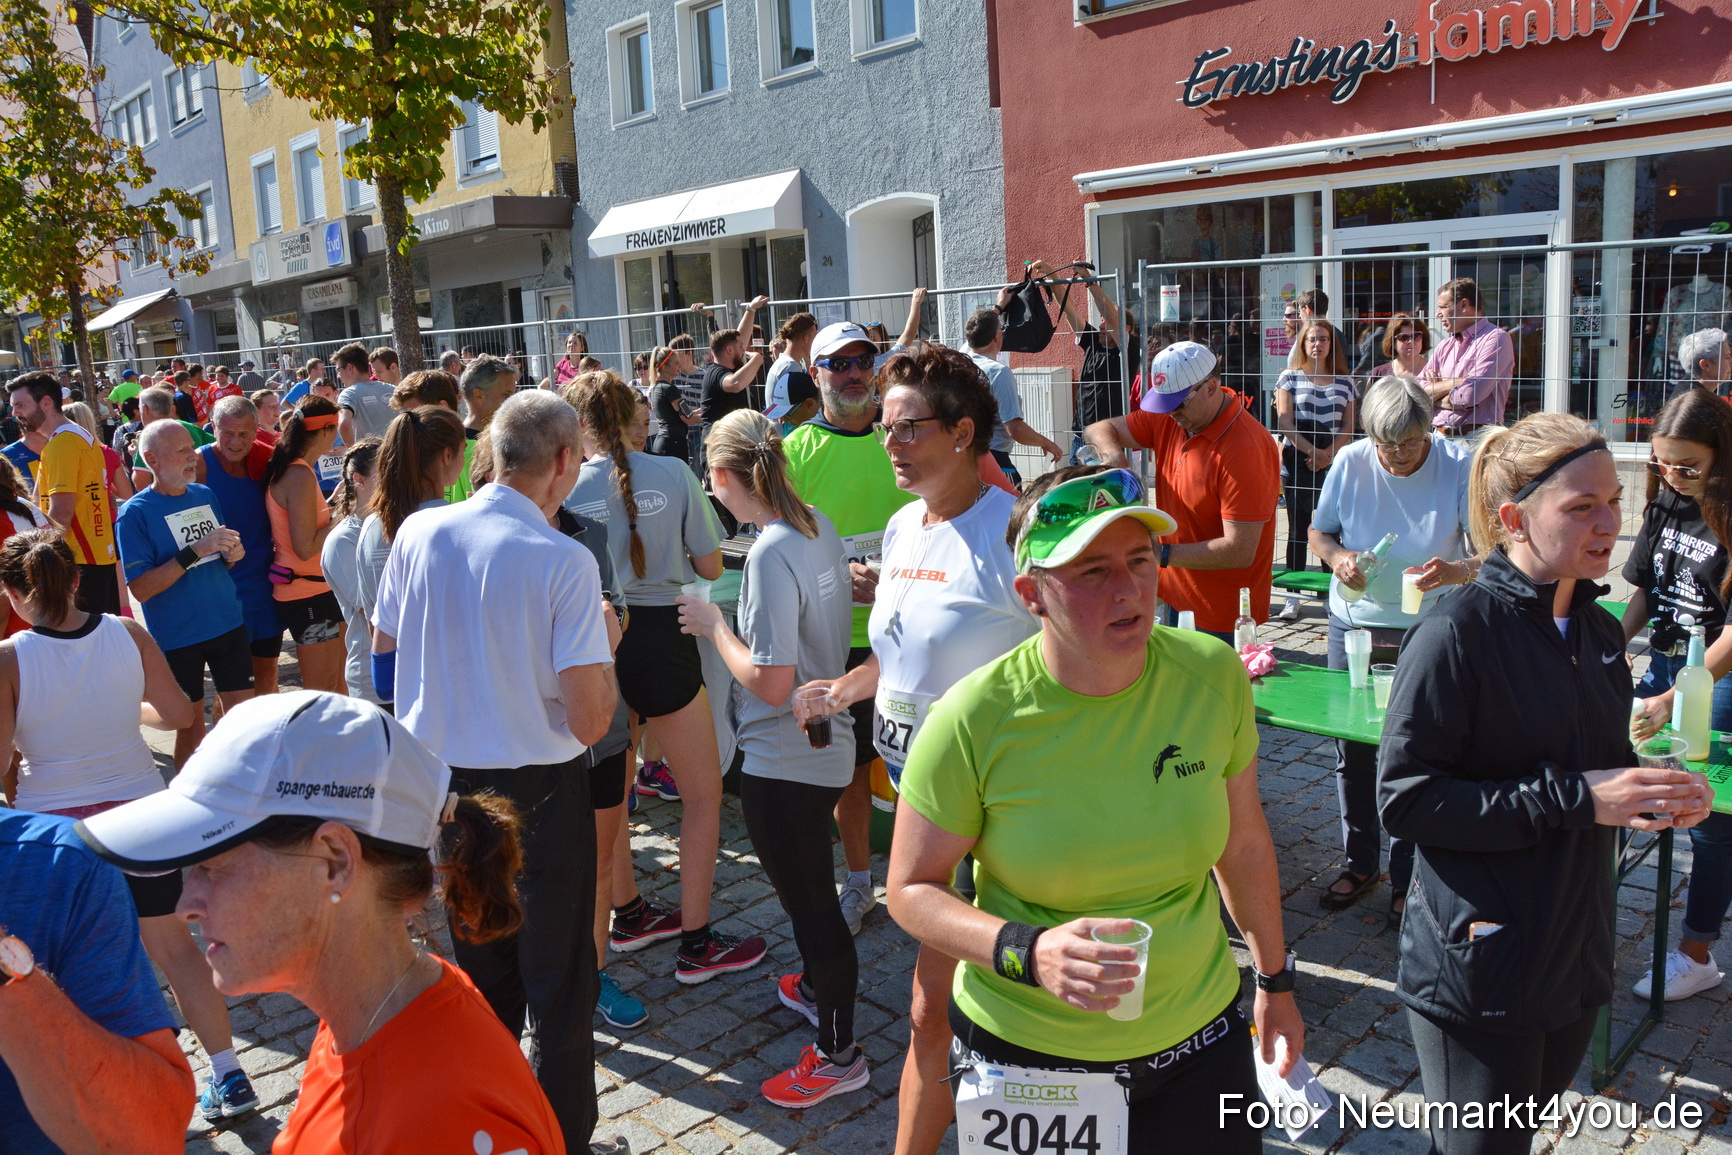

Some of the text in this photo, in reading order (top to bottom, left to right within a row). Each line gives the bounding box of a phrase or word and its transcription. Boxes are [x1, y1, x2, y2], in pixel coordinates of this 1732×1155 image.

[1182, 0, 1643, 108] Ernsting's family
[626, 217, 726, 249] FRAUENZIMMER
[822, 256, 833, 267] 24
[180, 520, 216, 544] 2568
[900, 569, 948, 583] KLEBL
[1174, 760, 1206, 779] Nina
[276, 780, 375, 800] spangenbauer.de
[1004, 1082, 1078, 1101] BOCK
[981, 1109, 1101, 1155] 2044
